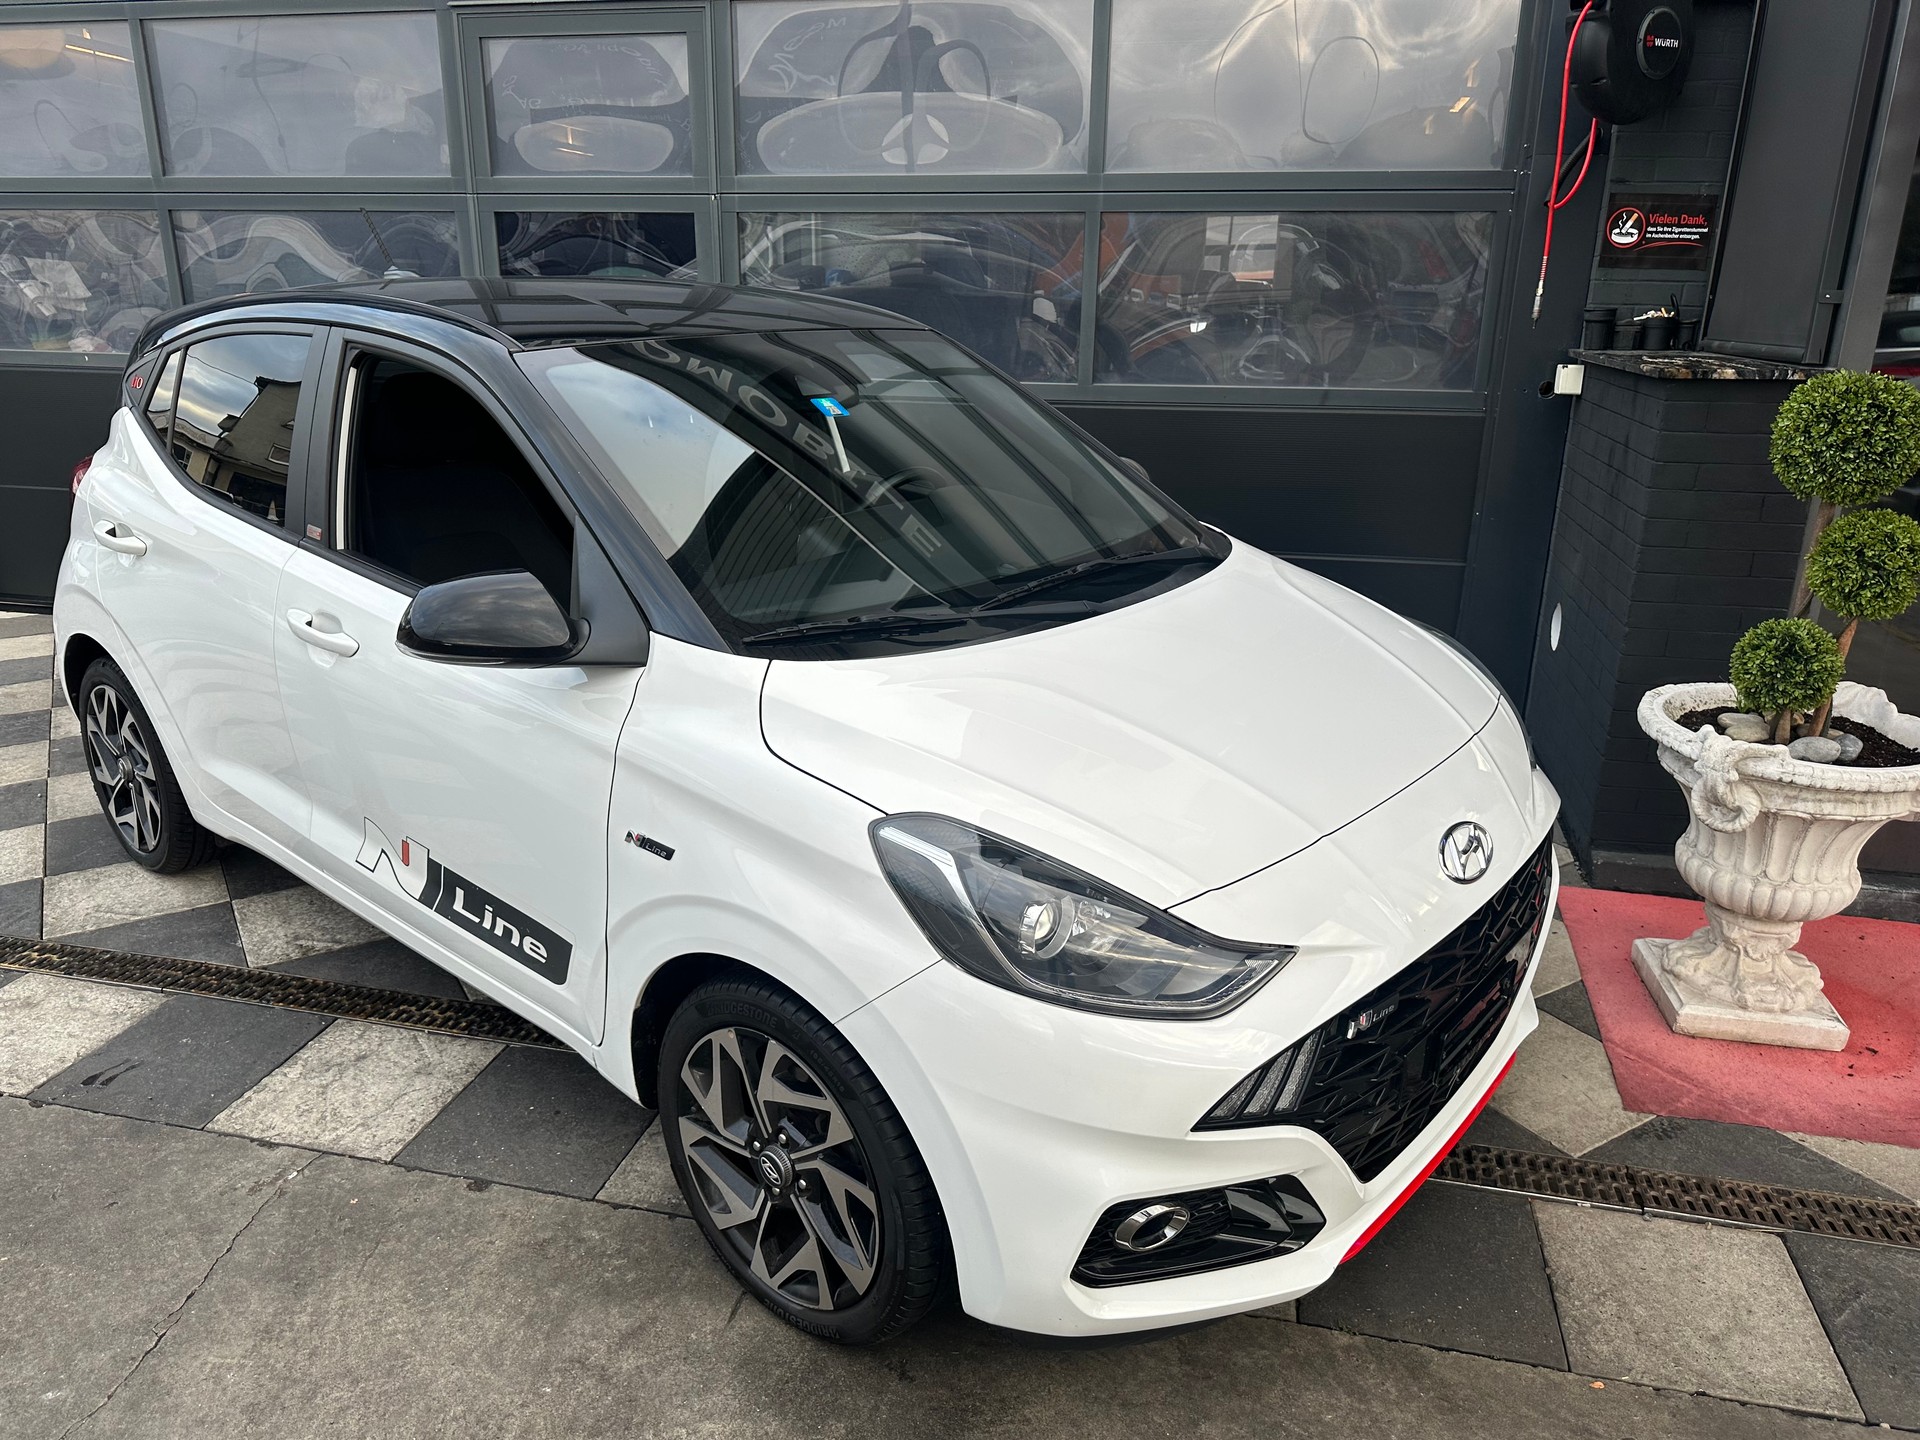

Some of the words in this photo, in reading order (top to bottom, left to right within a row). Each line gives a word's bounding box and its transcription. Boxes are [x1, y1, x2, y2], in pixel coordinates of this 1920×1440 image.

[1649, 213, 1678, 224] Vielen
[1681, 214, 1707, 226] Dank,
[645, 842, 667, 858] Line
[452, 886, 548, 964] Line
[706, 1001, 779, 1029] BRIDGESTONE
[1373, 1004, 1395, 1022] Line
